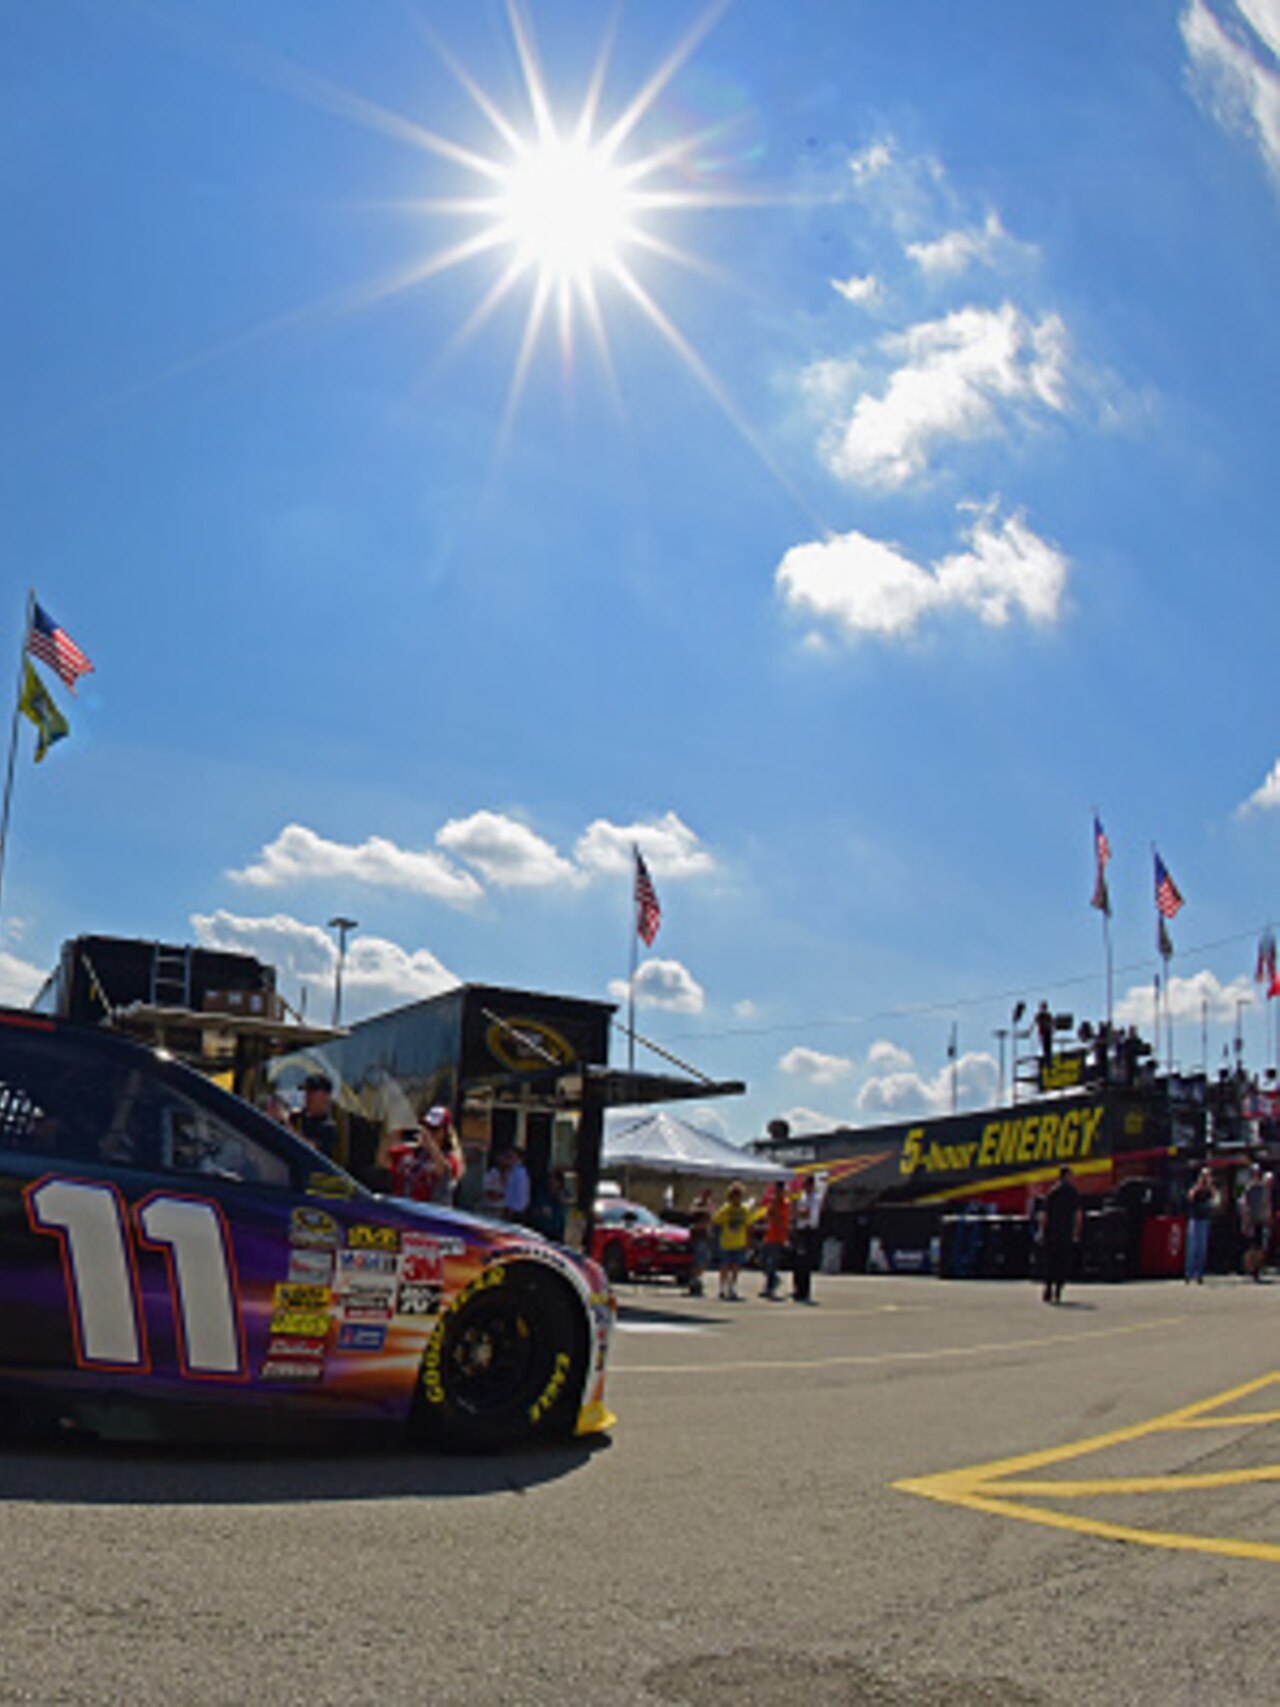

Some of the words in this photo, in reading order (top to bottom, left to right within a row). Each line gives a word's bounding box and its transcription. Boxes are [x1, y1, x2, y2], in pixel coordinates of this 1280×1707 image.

[898, 1128, 978, 1175] 5-hour
[976, 1106, 1104, 1167] ENERGY
[23, 1173, 250, 1382] 11
